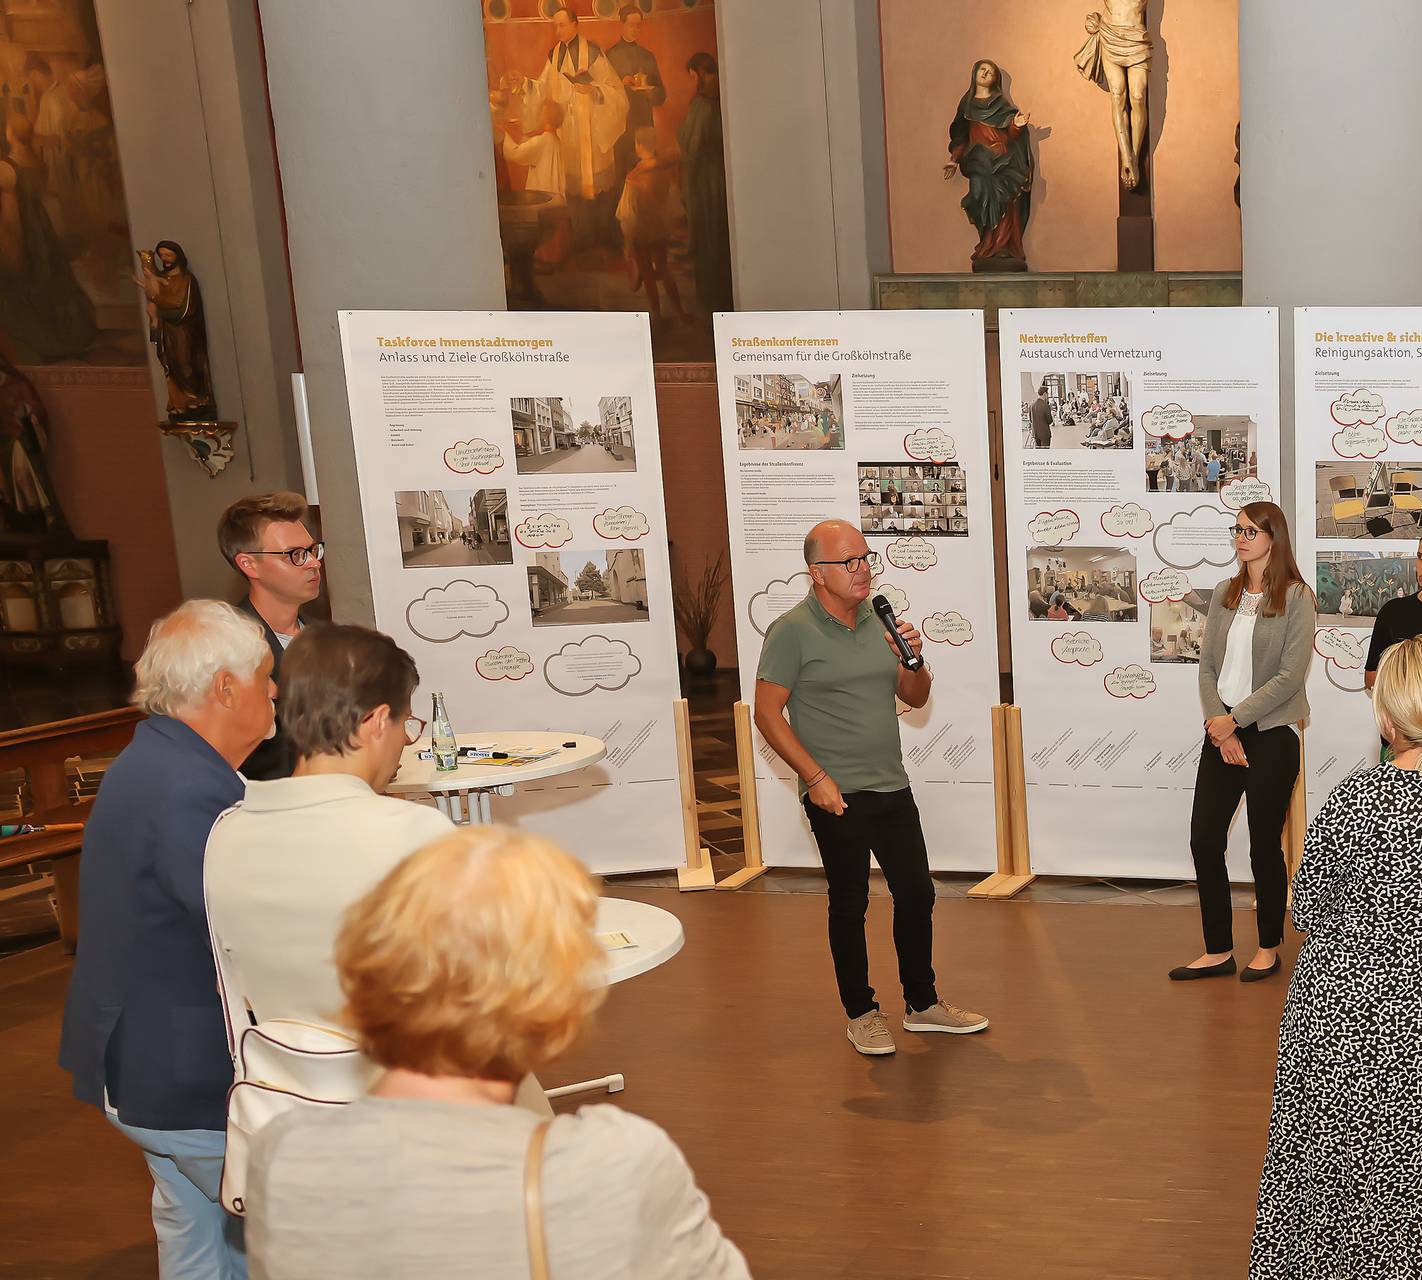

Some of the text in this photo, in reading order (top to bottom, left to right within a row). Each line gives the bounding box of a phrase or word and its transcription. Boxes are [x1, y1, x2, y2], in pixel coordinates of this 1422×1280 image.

[731, 336, 839, 347] Straßenkonferenzen
[1019, 333, 1108, 344] Netzwerktreffen
[1315, 332, 1334, 343] Die
[1336, 332, 1384, 343] kreative
[1387, 332, 1397, 343] &
[376, 337, 553, 350] Taskforce Innenstadtmorgen
[379, 352, 570, 363] Anlass und Ziele Großkölnstraße
[732, 350, 912, 362] Gemeinsam für die Großkölnstraße
[1019, 349, 1162, 361] Austausch und Vernetzung
[1315, 347, 1414, 360] Reinigungsaktion,
